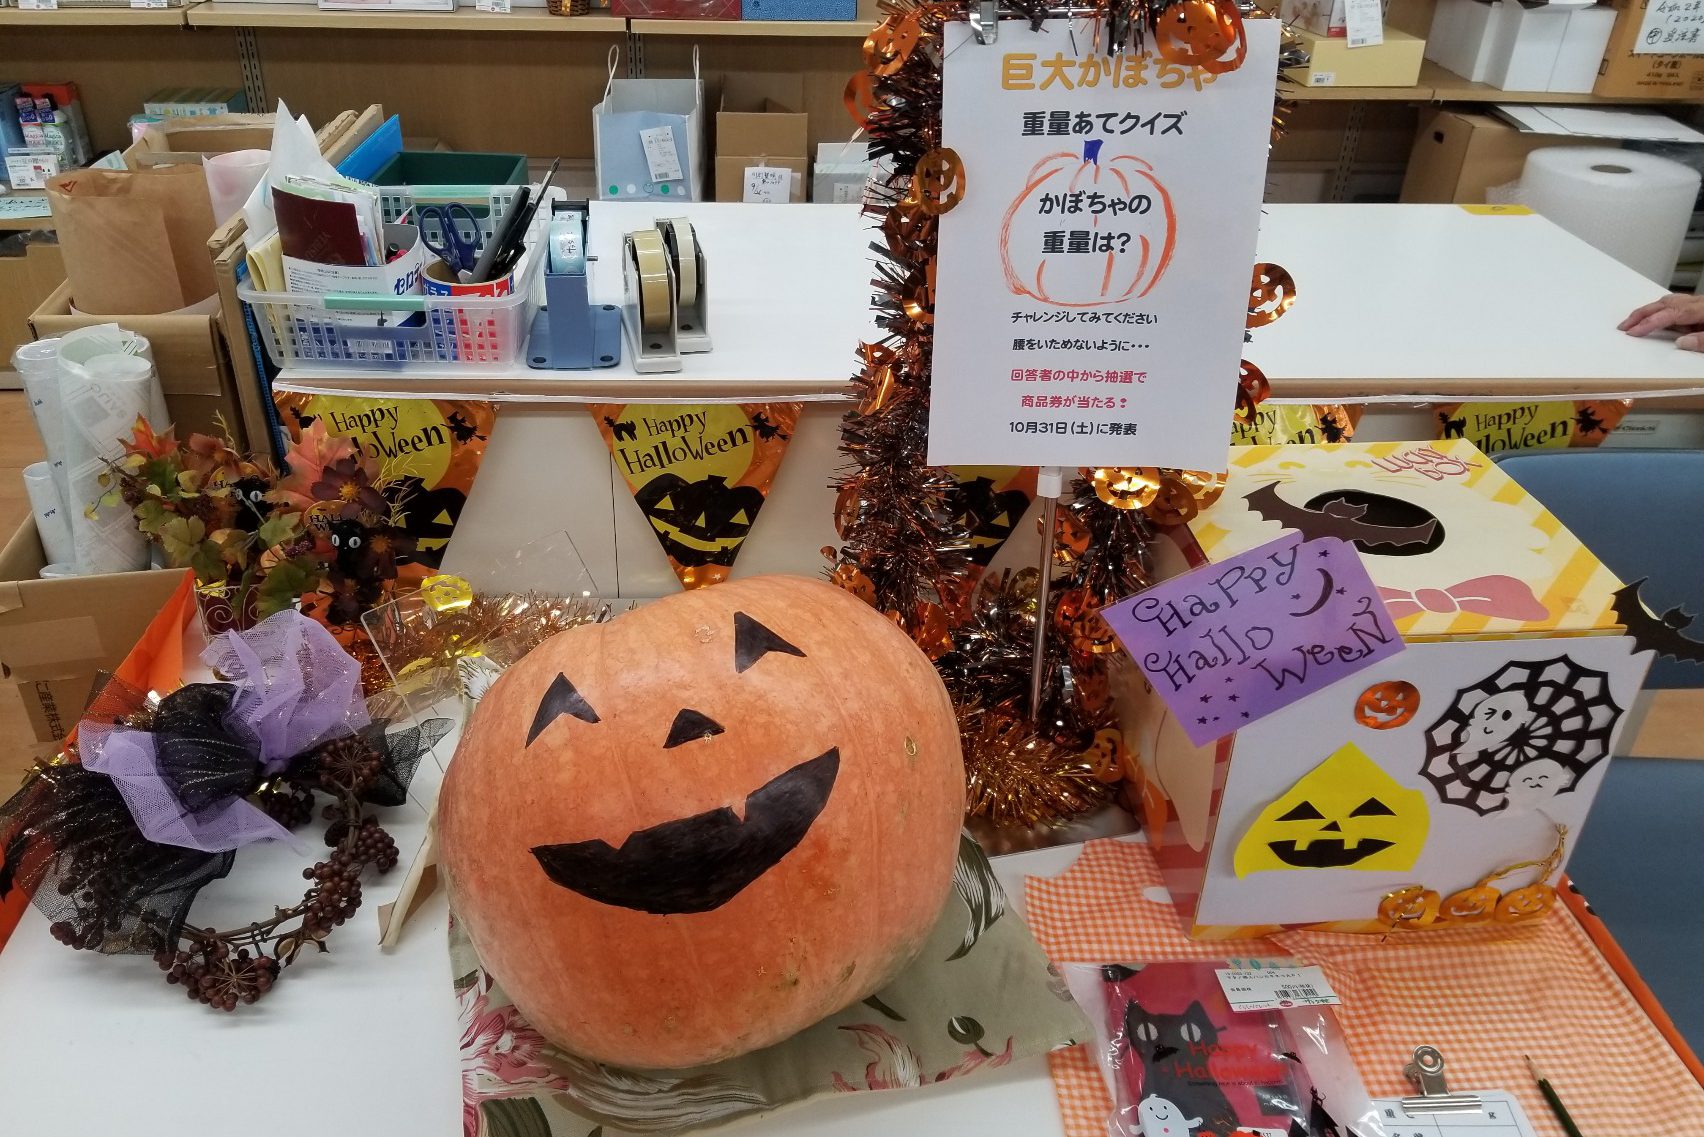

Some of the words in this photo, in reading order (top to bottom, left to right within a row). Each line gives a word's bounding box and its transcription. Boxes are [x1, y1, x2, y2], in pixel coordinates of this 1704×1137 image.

[1021, 110, 1188, 136] 重量あてクイズ
[1038, 189, 1152, 216] かぼちゃの
[1041, 230, 1132, 254] 重量は?
[1010, 311, 1158, 325] チャレンジしてみてください
[1010, 369, 1148, 384] 回答者の中から抽選で
[329, 405, 400, 434] Happy
[642, 410, 708, 438] Happy
[1009, 421, 1137, 436] 10月31日(土)に発表
[1231, 409, 1277, 440] appy
[1474, 404, 1539, 432] Happy
